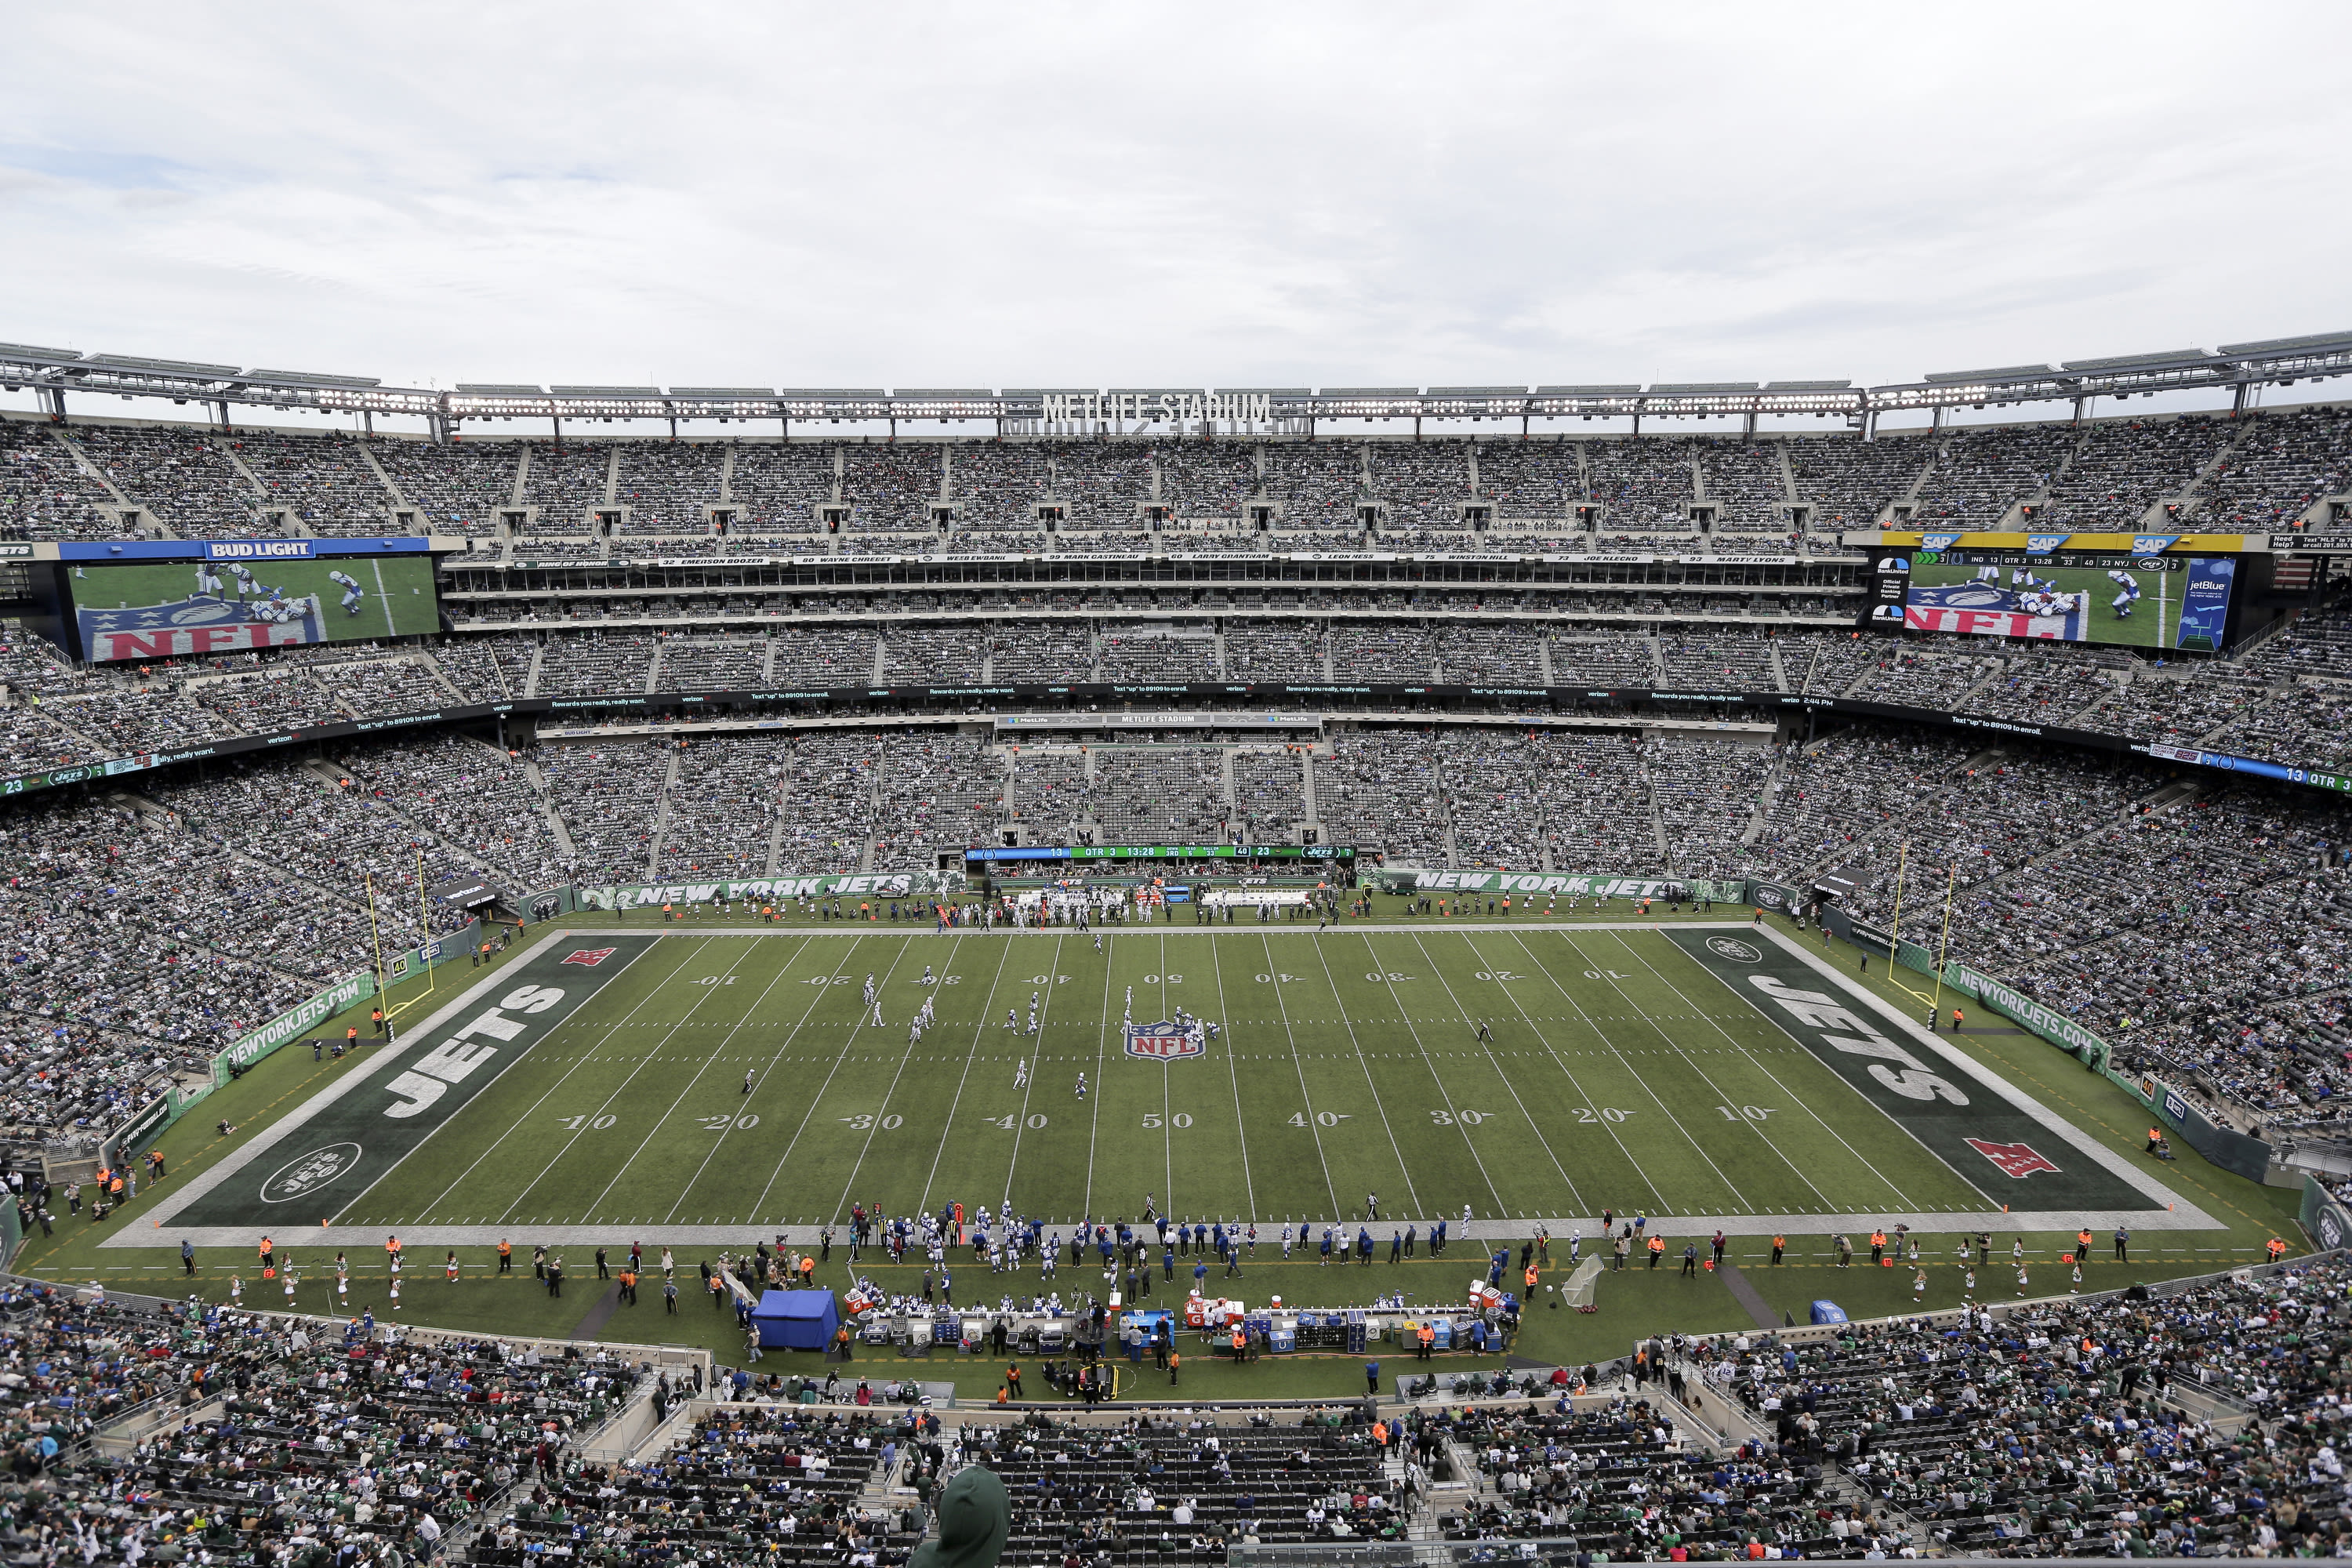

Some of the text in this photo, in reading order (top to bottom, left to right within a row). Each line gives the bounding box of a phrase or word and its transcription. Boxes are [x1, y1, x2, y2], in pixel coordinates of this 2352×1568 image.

[1043, 394, 1270, 423] METLIFE STADIUM
[211, 542, 309, 557] BUD LIGHT
[1922, 536, 1952, 549] SAP
[2027, 537, 2060, 551] SAP
[2132, 539, 2167, 554] SAP
[2190, 580, 2225, 590] jetBlue
[1905, 607, 2054, 638] NFL
[104, 624, 296, 661] NFL
[1990, 721, 2013, 730] 89109
[2020, 726, 2042, 735] enroll.
[267, 734, 292, 744] verizon
[173, 747, 216, 760] really want.
[2175, 749, 2198, 760] 825
[55, 770, 83, 782] JETS
[2286, 768, 2303, 782] 13
[2310, 773, 2350, 790] QTR 3
[5, 779, 24, 794] 23
[1051, 848, 1062, 857] 13
[1085, 848, 1116, 856] QTR 3
[1127, 848, 1155, 856] 13:28
[1257, 847, 1269, 856] 23
[1414, 872, 1593, 898] NEW YORK
[1828, 875, 1855, 887] verizon
[445, 885, 485, 900] verizon
[636, 874, 913, 905] NEW YORK JETS
[1828, 887, 1842, 897] STADIUM
[393, 959, 406, 975] 40
[810, 975, 852, 985] 20
[1033, 974, 1073, 985] 40
[1143, 974, 1184, 984] 50
[1255, 972, 1296, 985] 40
[1365, 971, 1407, 983] 30
[1474, 970, 1517, 982] 20
[1960, 969, 2092, 1055] NEWYORKJETS.COM
[227, 981, 359, 1066] NEWYORKJETS.COM
[2010, 1011, 2045, 1035] FOR TICKETS
[282, 1020, 316, 1044] FOR TICKETS
[1134, 1037, 1196, 1056] NFL
[1747, 975, 1971, 1106] JETS
[383, 985, 565, 1119] JETS
[2142, 1078, 2153, 1095] 40
[1572, 1107, 1624, 1123] 20
[1715, 1105, 1768, 1122] 10
[2173, 1103, 2183, 1116] NFL
[563, 1114, 617, 1131] 10
[702, 1113, 760, 1131] 20
[849, 1113, 903, 1131] 30
[994, 1113, 1047, 1131] 40
[1142, 1112, 1194, 1130] 50
[1287, 1111, 1338, 1128] 40
[1430, 1110, 1483, 1127] 30
[1191, 1315, 1201, 1324] G
[566, 1462, 577, 1474] 16
[2102, 1473, 2112, 1484] 14
